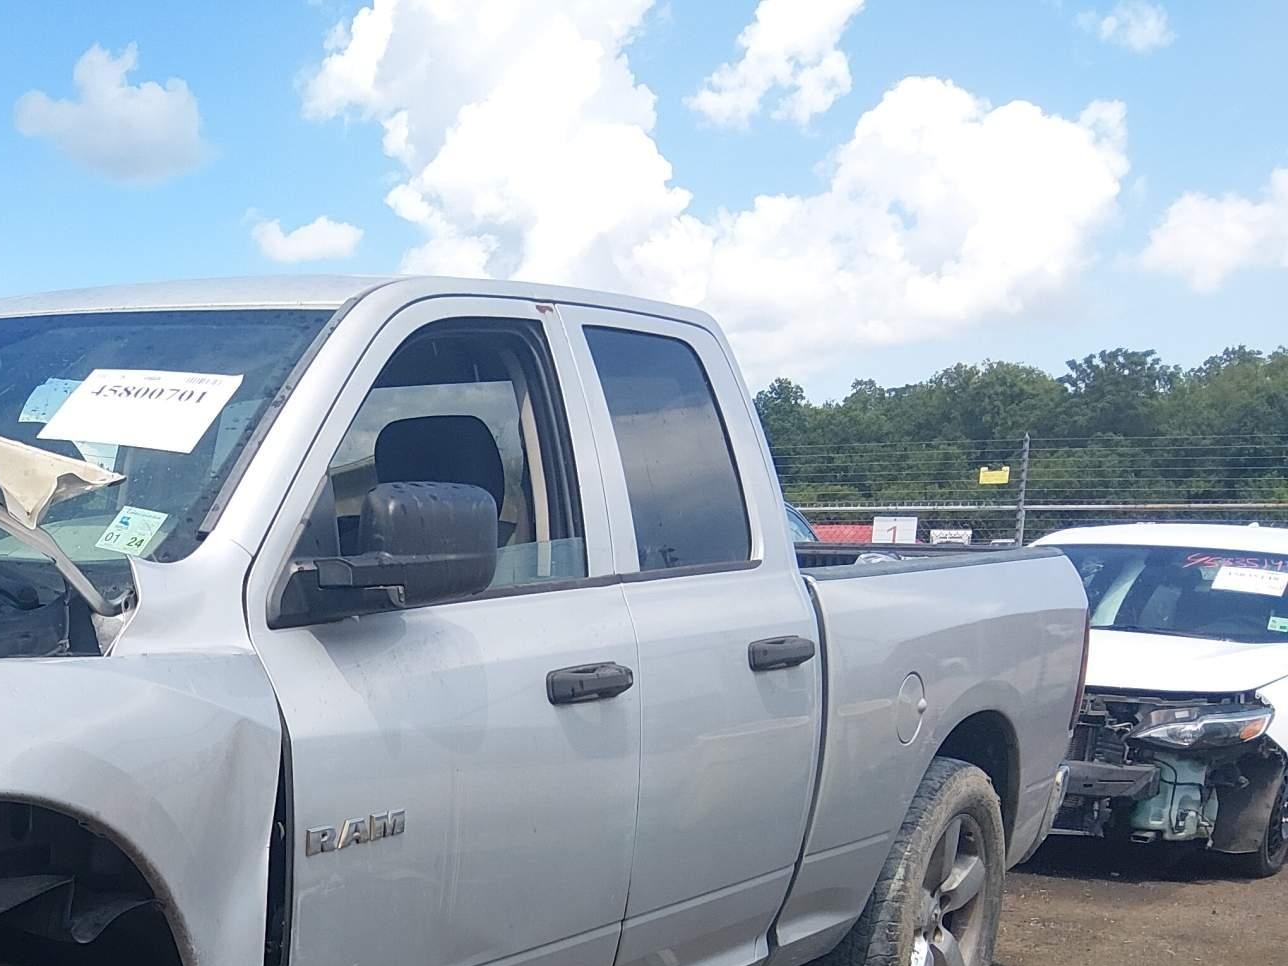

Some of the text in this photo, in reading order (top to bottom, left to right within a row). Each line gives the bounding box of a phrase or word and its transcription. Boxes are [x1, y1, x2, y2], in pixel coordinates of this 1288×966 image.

[91, 384, 208, 404] 45800701
[104, 531, 145, 549] 01 24
[305, 809, 406, 857] RAM
